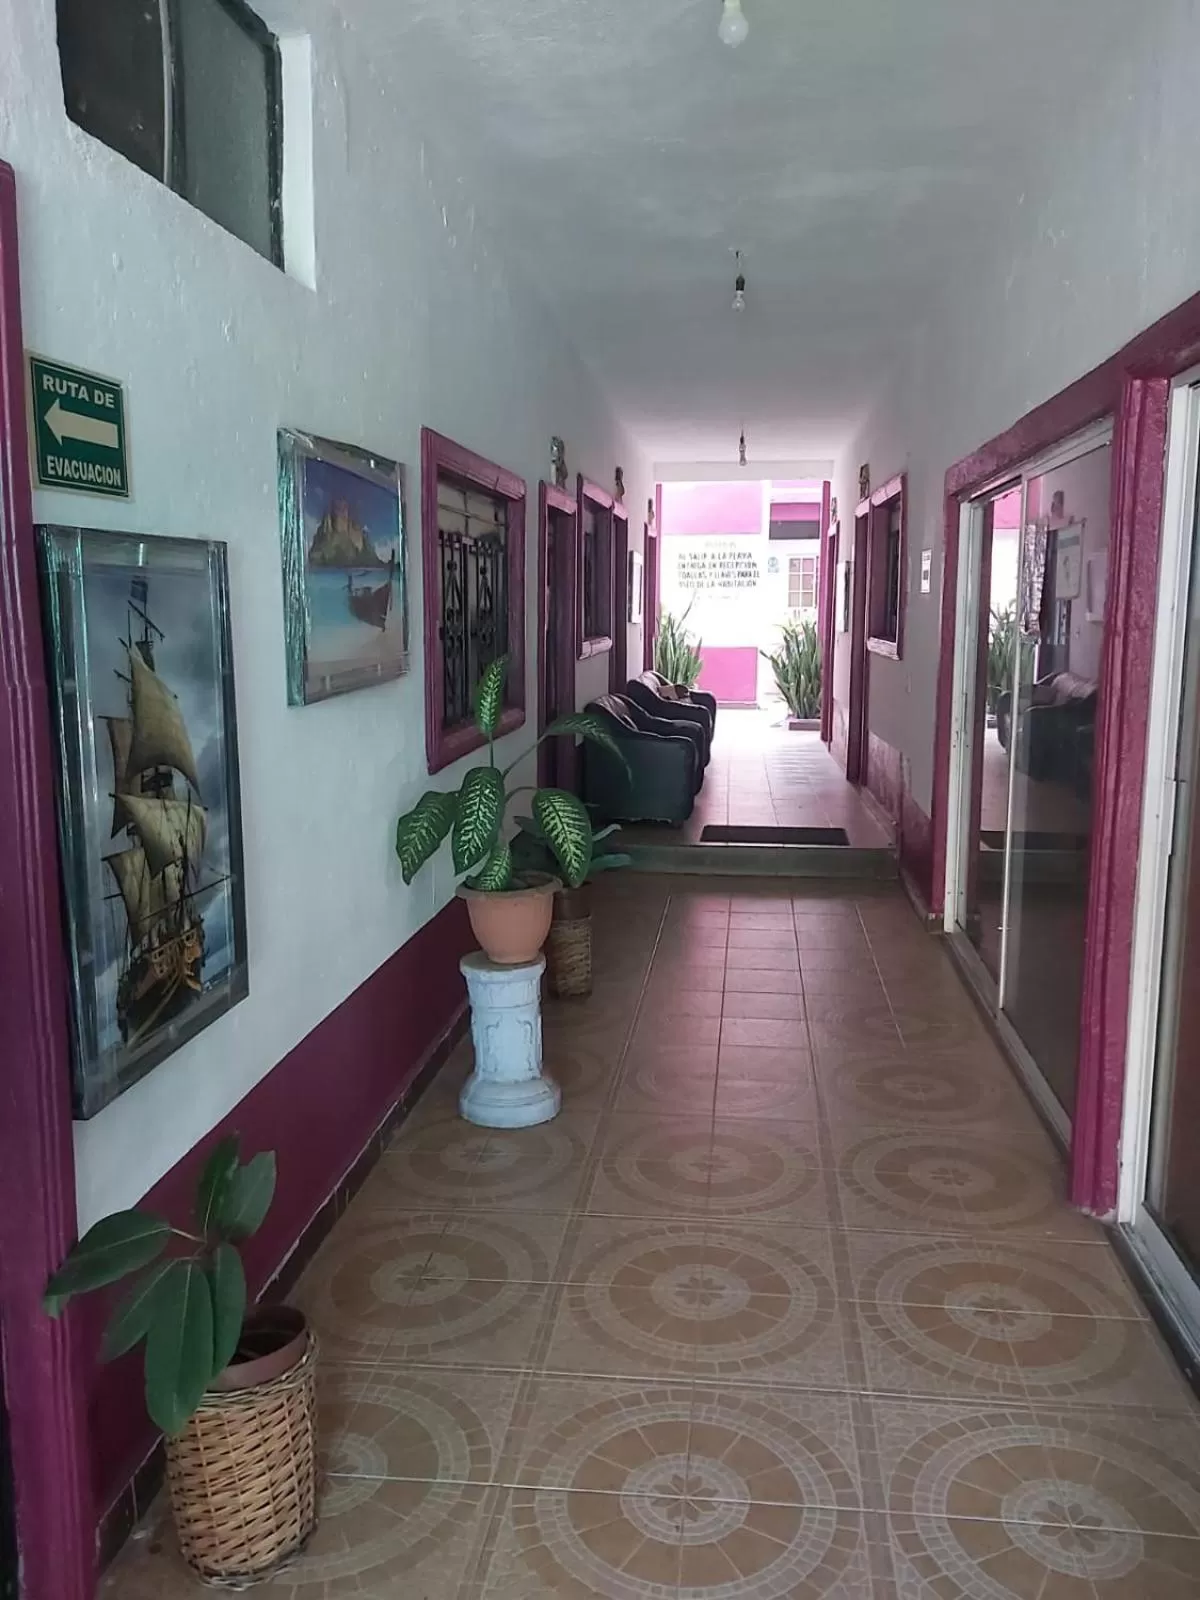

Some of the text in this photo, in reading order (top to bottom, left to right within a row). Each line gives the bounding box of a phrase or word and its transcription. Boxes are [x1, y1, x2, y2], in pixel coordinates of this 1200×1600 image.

[42, 374, 115, 408] RUTA DE
[46, 454, 122, 486] EVACUACION
[711, 552, 716, 560] A
[718, 552, 727, 560] LA
[729, 551, 752, 560] PLAYA
